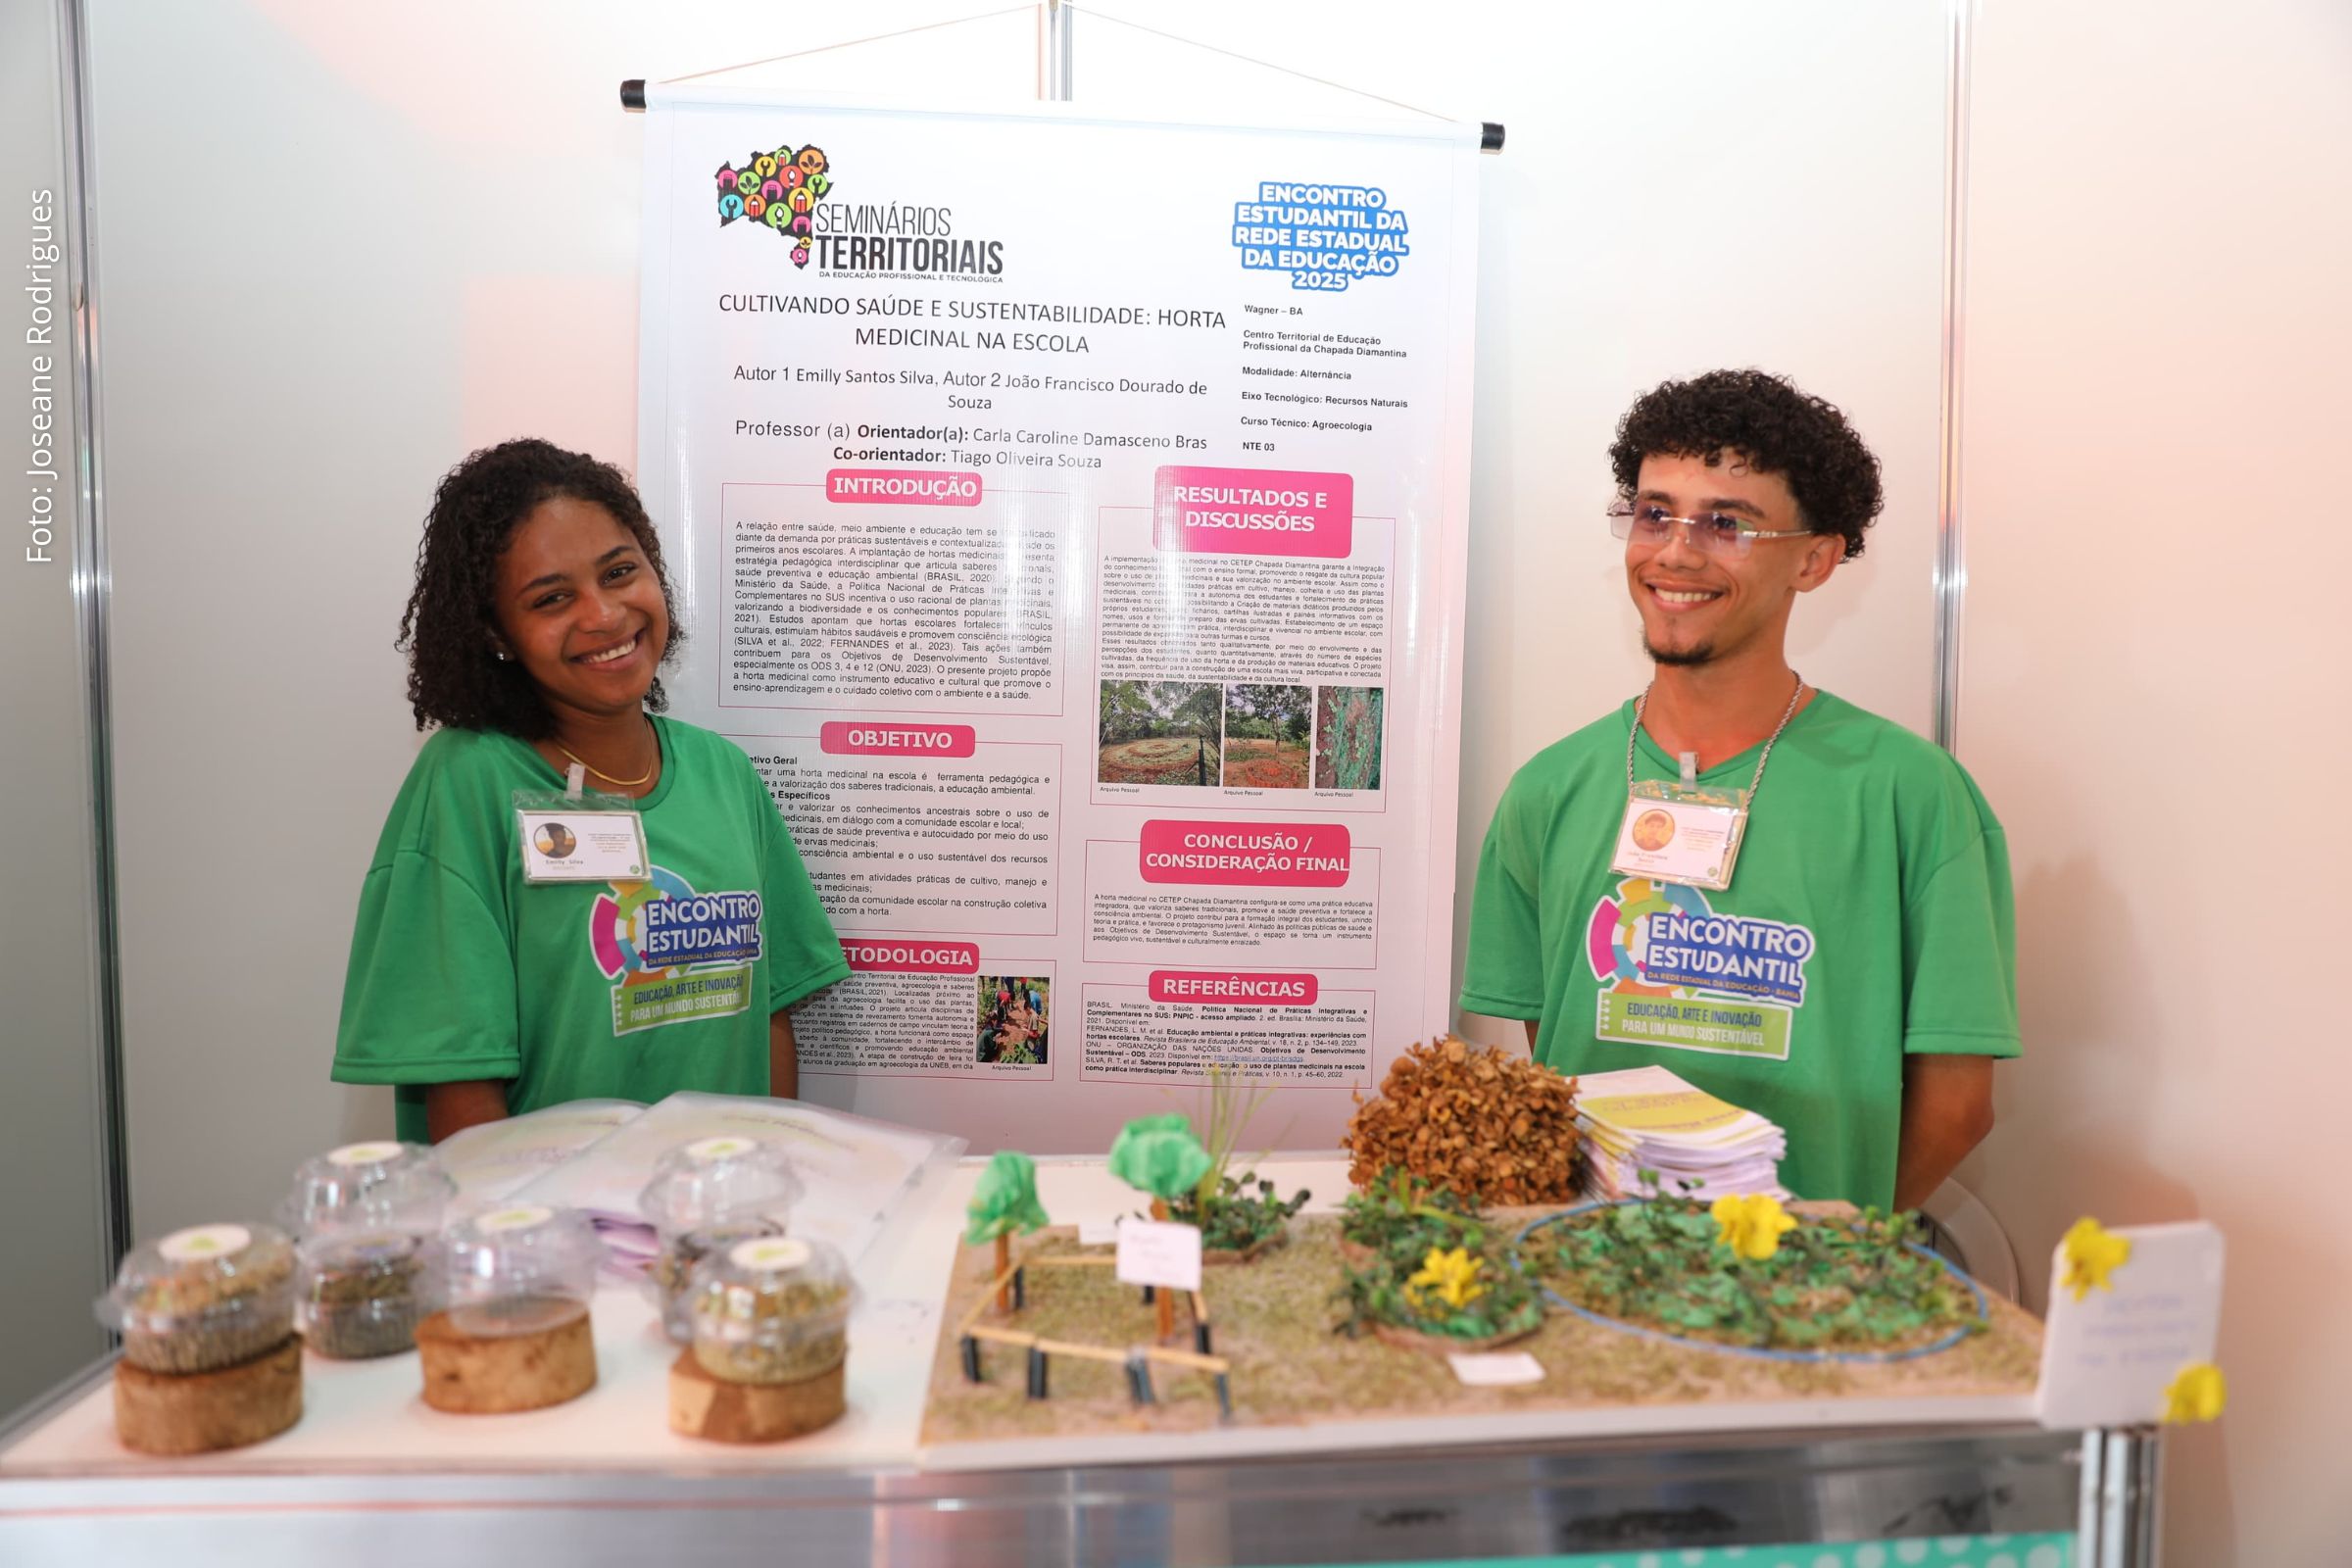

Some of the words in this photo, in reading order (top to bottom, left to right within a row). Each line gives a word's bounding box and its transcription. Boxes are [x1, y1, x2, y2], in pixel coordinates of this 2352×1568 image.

[1262, 184, 1383, 208] ENCONTRO
[815, 201, 951, 236] SEMINÁRIOS
[1238, 205, 1372, 229] ESTUDANTIL
[1376, 212, 1404, 230] DA
[1236, 226, 1291, 246] REDE
[1297, 229, 1406, 252] ESTADUAL
[815, 235, 1004, 274] TERRITORIAIS
[1246, 249, 1274, 267] DA
[1279, 250, 1396, 275] EDUCAÇÃO
[833, 270, 877, 280] EDUCAÇÃO
[947, 274, 1004, 283] TECNOLÓGICA
[1296, 271, 1347, 289] 2025
[719, 294, 850, 316] CULTIVANDO
[857, 294, 923, 317] SAÚDE
[932, 300, 941, 318] E
[949, 301, 1151, 325] SUSTENTABILIDADE:
[1158, 310, 1226, 328] HORTA
[1245, 305, 1278, 316] Wagner
[1290, 307, 1303, 316] BA
[856, 328, 970, 349] MEDICINAL
[977, 332, 1005, 350] NA
[1013, 333, 1089, 353] ESCOLA
[1244, 330, 1274, 339] Centro
[1277, 332, 1321, 341] Territorial
[1337, 335, 1381, 346] Educação
[1244, 341, 1298, 352] Profissional
[1299, 344, 1311, 353] da
[1314, 345, 1353, 356] Chapada
[1356, 347, 1407, 358] Diamantina
[734, 365, 776, 380] Autor
[783, 367, 789, 380] 1
[797, 368, 841, 386] Emilly
[846, 370, 896, 384] Santos
[900, 370, 939, 386] Silva,
[943, 370, 986, 386] Autor
[991, 372, 1002, 387] 2
[1005, 374, 1039, 389] João
[1045, 376, 1114, 392] Francisco
[1119, 379, 1184, 393] Dourado
[1189, 381, 1207, 394] de
[1243, 367, 1298, 376] Modalidade:
[1300, 369, 1351, 380] Alternância
[949, 395, 992, 410] Souza
[1264, 393, 1322, 404] Tecnológico:
[1325, 396, 1368, 406] Recursos
[1370, 398, 1407, 408] Naturais
[735, 420, 820, 437] Professor
[827, 423, 851, 441] (a)
[858, 425, 968, 443] Orientador(a):
[973, 428, 1011, 442] Carla
[1016, 429, 1078, 445] Caroline
[1084, 433, 1170, 448] Damasceno
[1176, 435, 1206, 449] Bras
[1271, 417, 1309, 427] Técnico:
[1312, 420, 1372, 432] Agroecologia
[834, 447, 947, 463] Co-orientador:
[951, 450, 991, 466] Tiago
[997, 452, 1053, 466] Oliveira
[1058, 454, 1102, 467] Souza
[1243, 442, 1261, 451] NTE
[835, 475, 976, 500] INTRODUÇÃO
[1174, 486, 1309, 508] RESULTADOS
[1315, 493, 1327, 508] E
[1186, 511, 1315, 532] DISCUSSÕES
[734, 684, 824, 694] ensino-aprendizagem
[843, 686, 876, 695] cuidado
[944, 689, 984, 698] ambiente
[1003, 690, 1031, 699] saúde.
[848, 730, 953, 749] OBJETIVO
[778, 791, 830, 801] Específicos
[1184, 833, 1298, 851] CONCLUSÃO
[1147, 853, 1291, 873] CONSIDERAÇÃO
[1296, 857, 1349, 872] FINAL
[648, 898, 760, 926] ENCONTRO
[649, 924, 759, 953] ESTUDANTIL
[1652, 915, 1807, 956] ENCONTRO
[842, 947, 973, 965] TODOLOGIA
[1648, 945, 1800, 986] ESTUDANTIL
[635, 984, 674, 1004] EDUCAÇÃO,
[676, 982, 696, 996] ARTE
[699, 981, 703, 992] E
[1163, 976, 1305, 998] REFERÊNCIAS
[1725, 981, 1770, 995] EDUCAÇÃO
[631, 1007, 651, 1022] PARA
[652, 1005, 662, 1018] UM
[664, 1000, 693, 1015] MUNDO
[1628, 1003, 1680, 1020] EDUCAÇÃO,
[1682, 1007, 1701, 1021] ARTE
[1703, 1009, 1708, 1022] E
[1711, 1010, 1762, 1028] INOVAÇÃO
[1622, 1019, 1646, 1034] PARA
[1650, 1022, 1665, 1035] UM
[1696, 1027, 1764, 1047] SUSTENTÁVEL
[1117, 1042, 1166, 1052] ORGANIZAÇÃO
[1193, 1045, 1221, 1054] NAÇÕES
